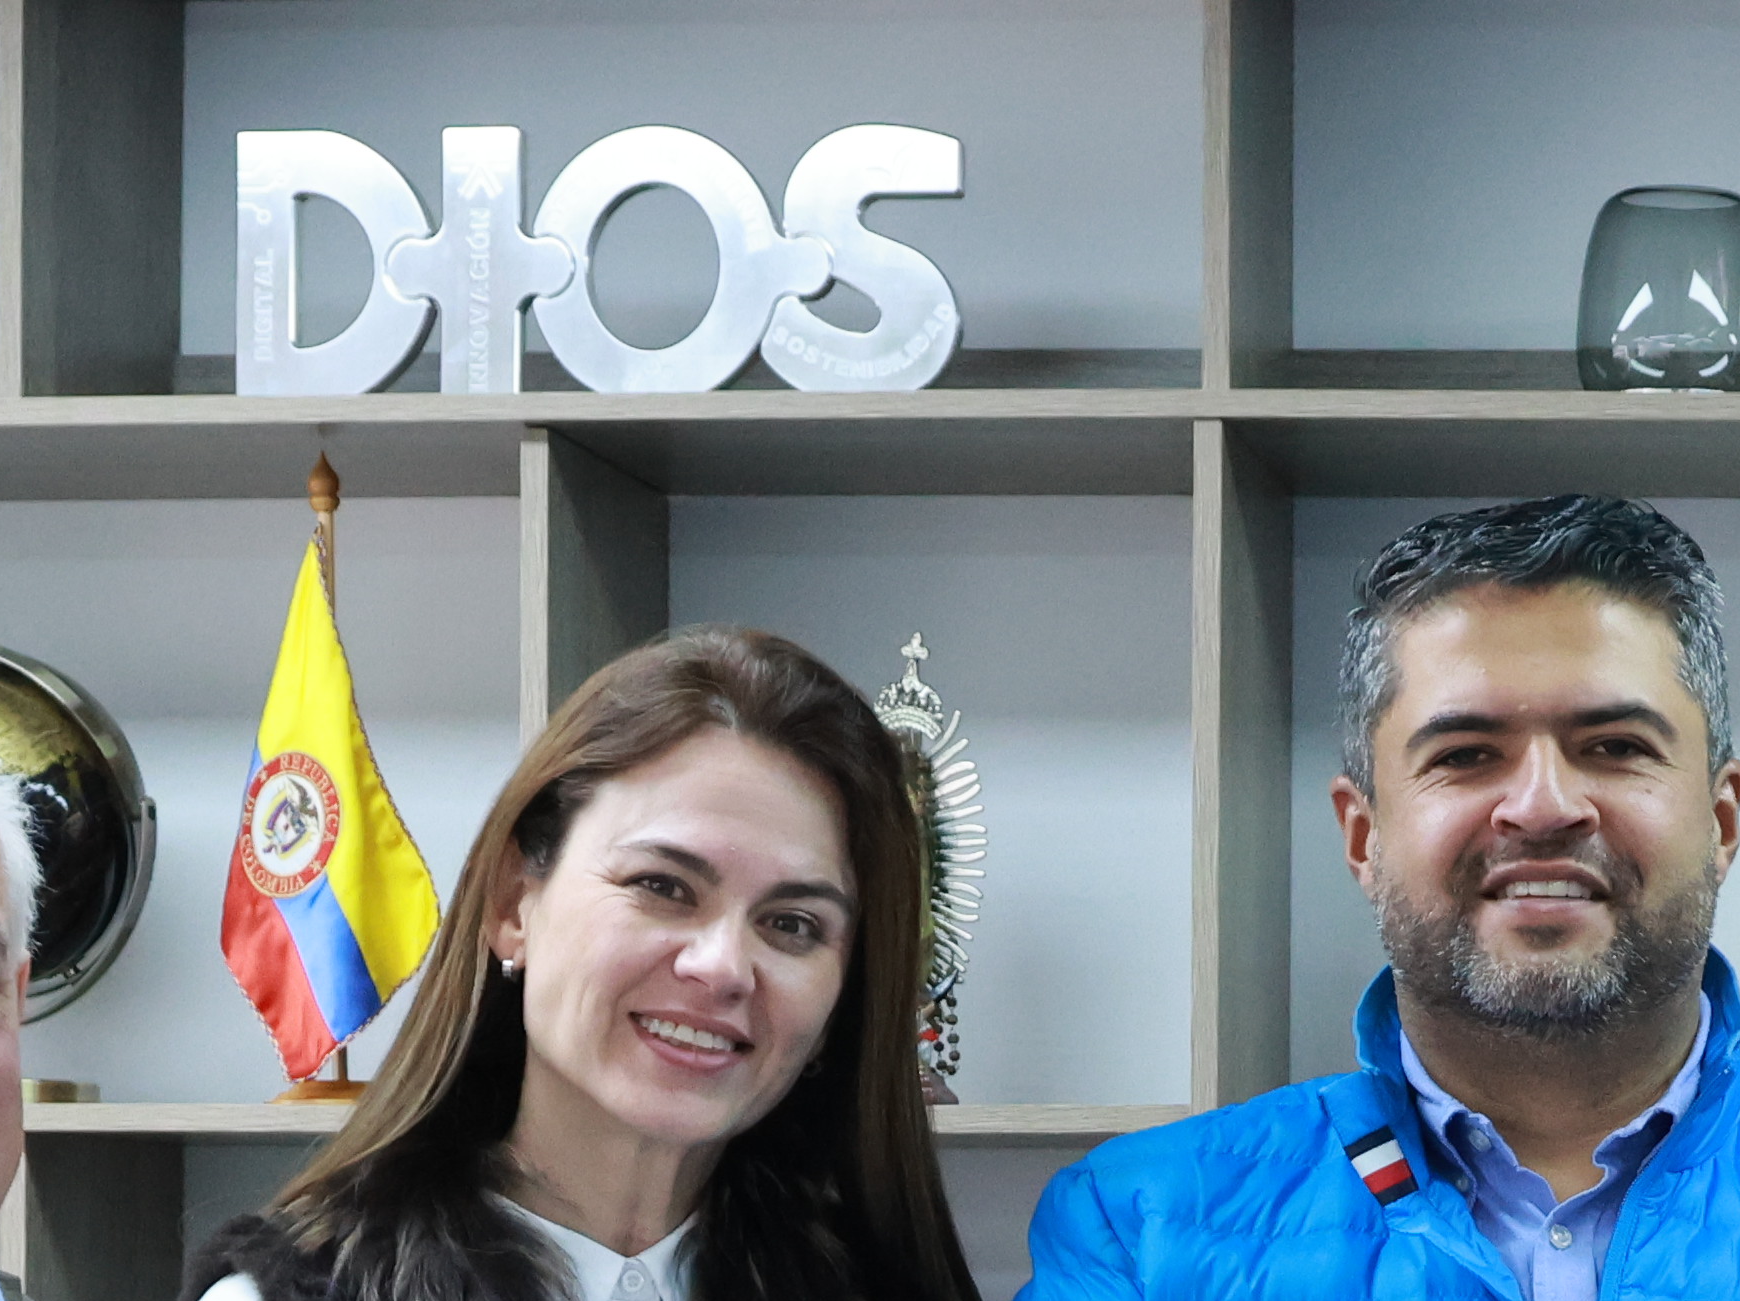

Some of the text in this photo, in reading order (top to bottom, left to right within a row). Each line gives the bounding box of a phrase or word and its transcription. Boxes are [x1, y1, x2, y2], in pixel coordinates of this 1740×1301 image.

[253, 248, 275, 362] DIGITAL
[466, 206, 491, 393] INNOVACIÓN
[770, 302, 955, 379] SOSTENIBILIDAD
[243, 793, 255, 826] DE
[280, 753, 339, 842] REPUBLICA
[240, 834, 306, 894] COLOMBIA
